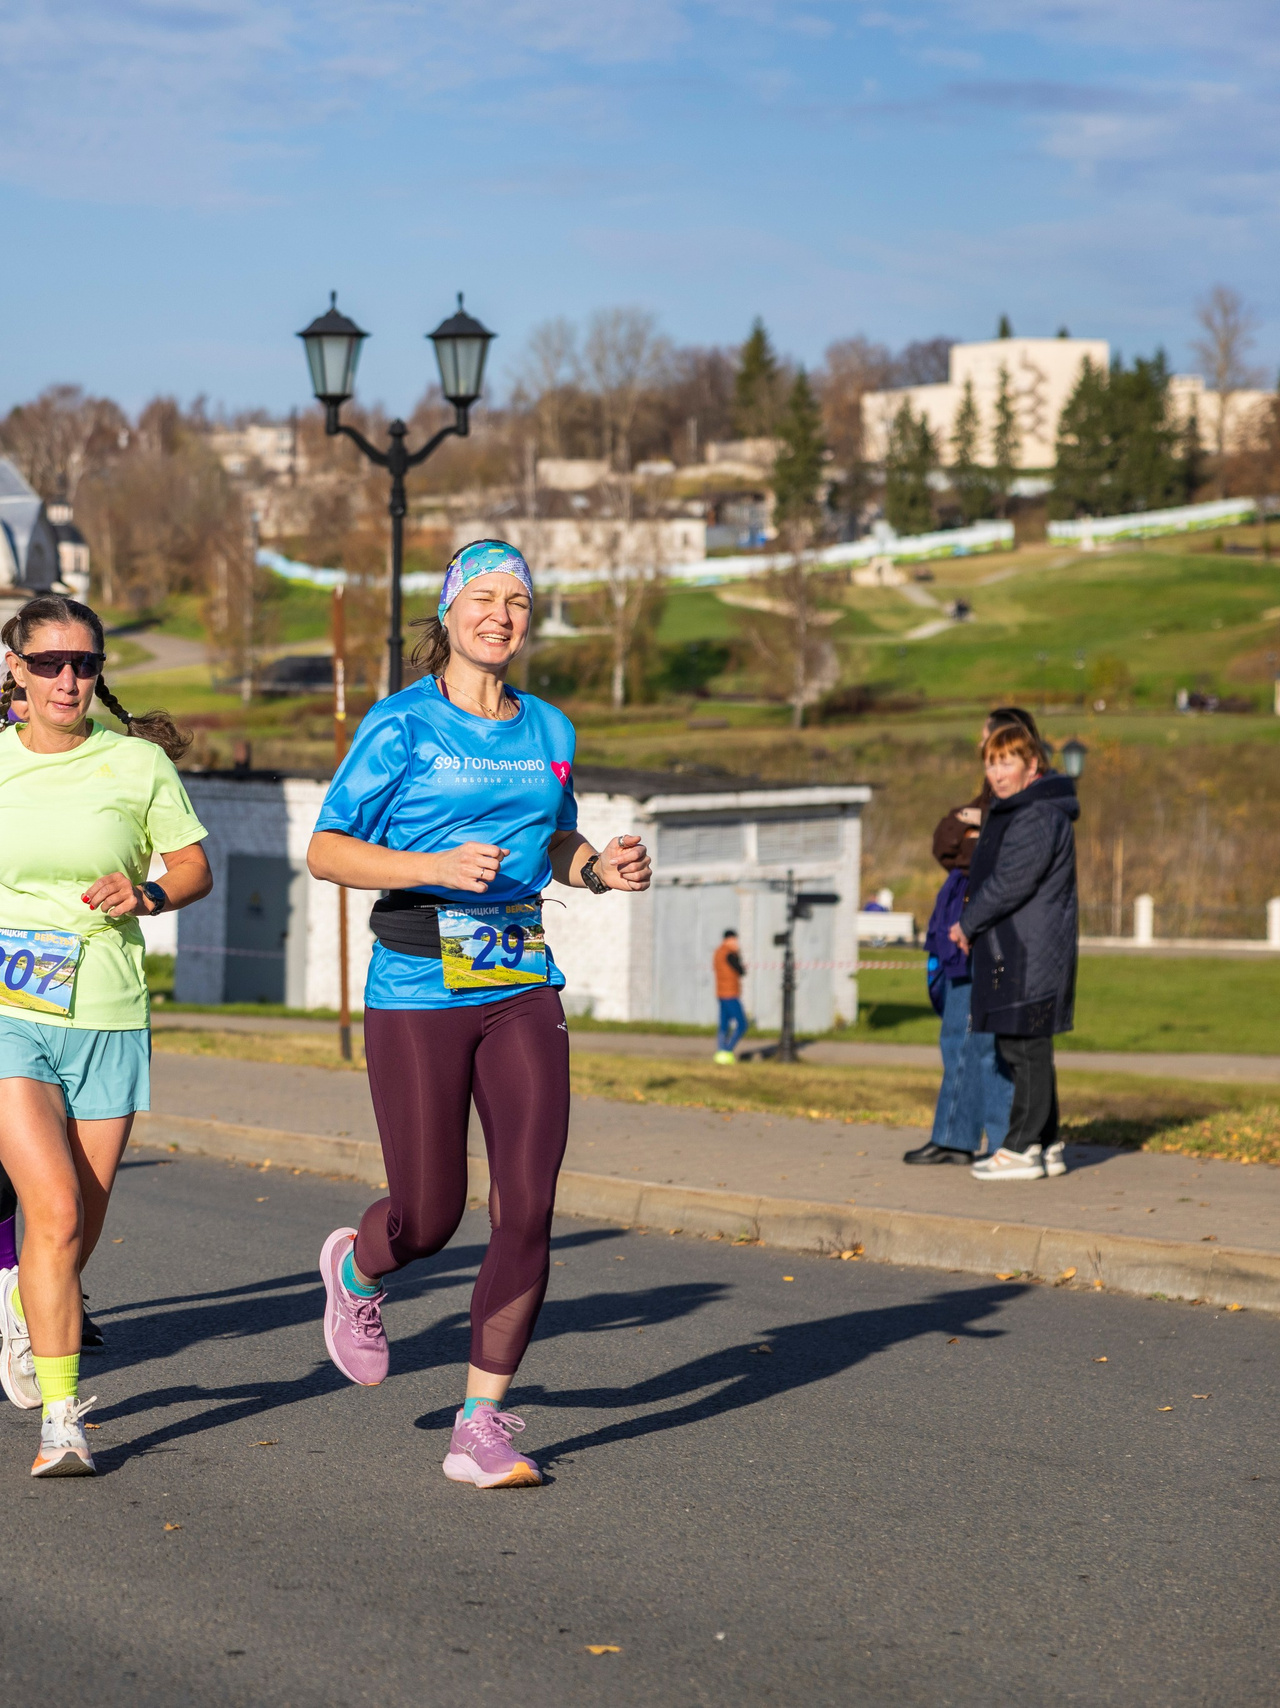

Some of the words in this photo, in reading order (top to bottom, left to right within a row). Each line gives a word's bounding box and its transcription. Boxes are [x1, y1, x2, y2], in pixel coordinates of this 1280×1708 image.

[433, 756, 460, 770] S95
[464, 757, 545, 771] ГОЛЬЯНОВО
[455, 776, 502, 784] ЛЮБОВЬЮ
[446, 906, 500, 918] СТАРИЦКИЕ
[34, 932, 74, 946] ВЕРСТЫ
[471, 924, 525, 971] 29
